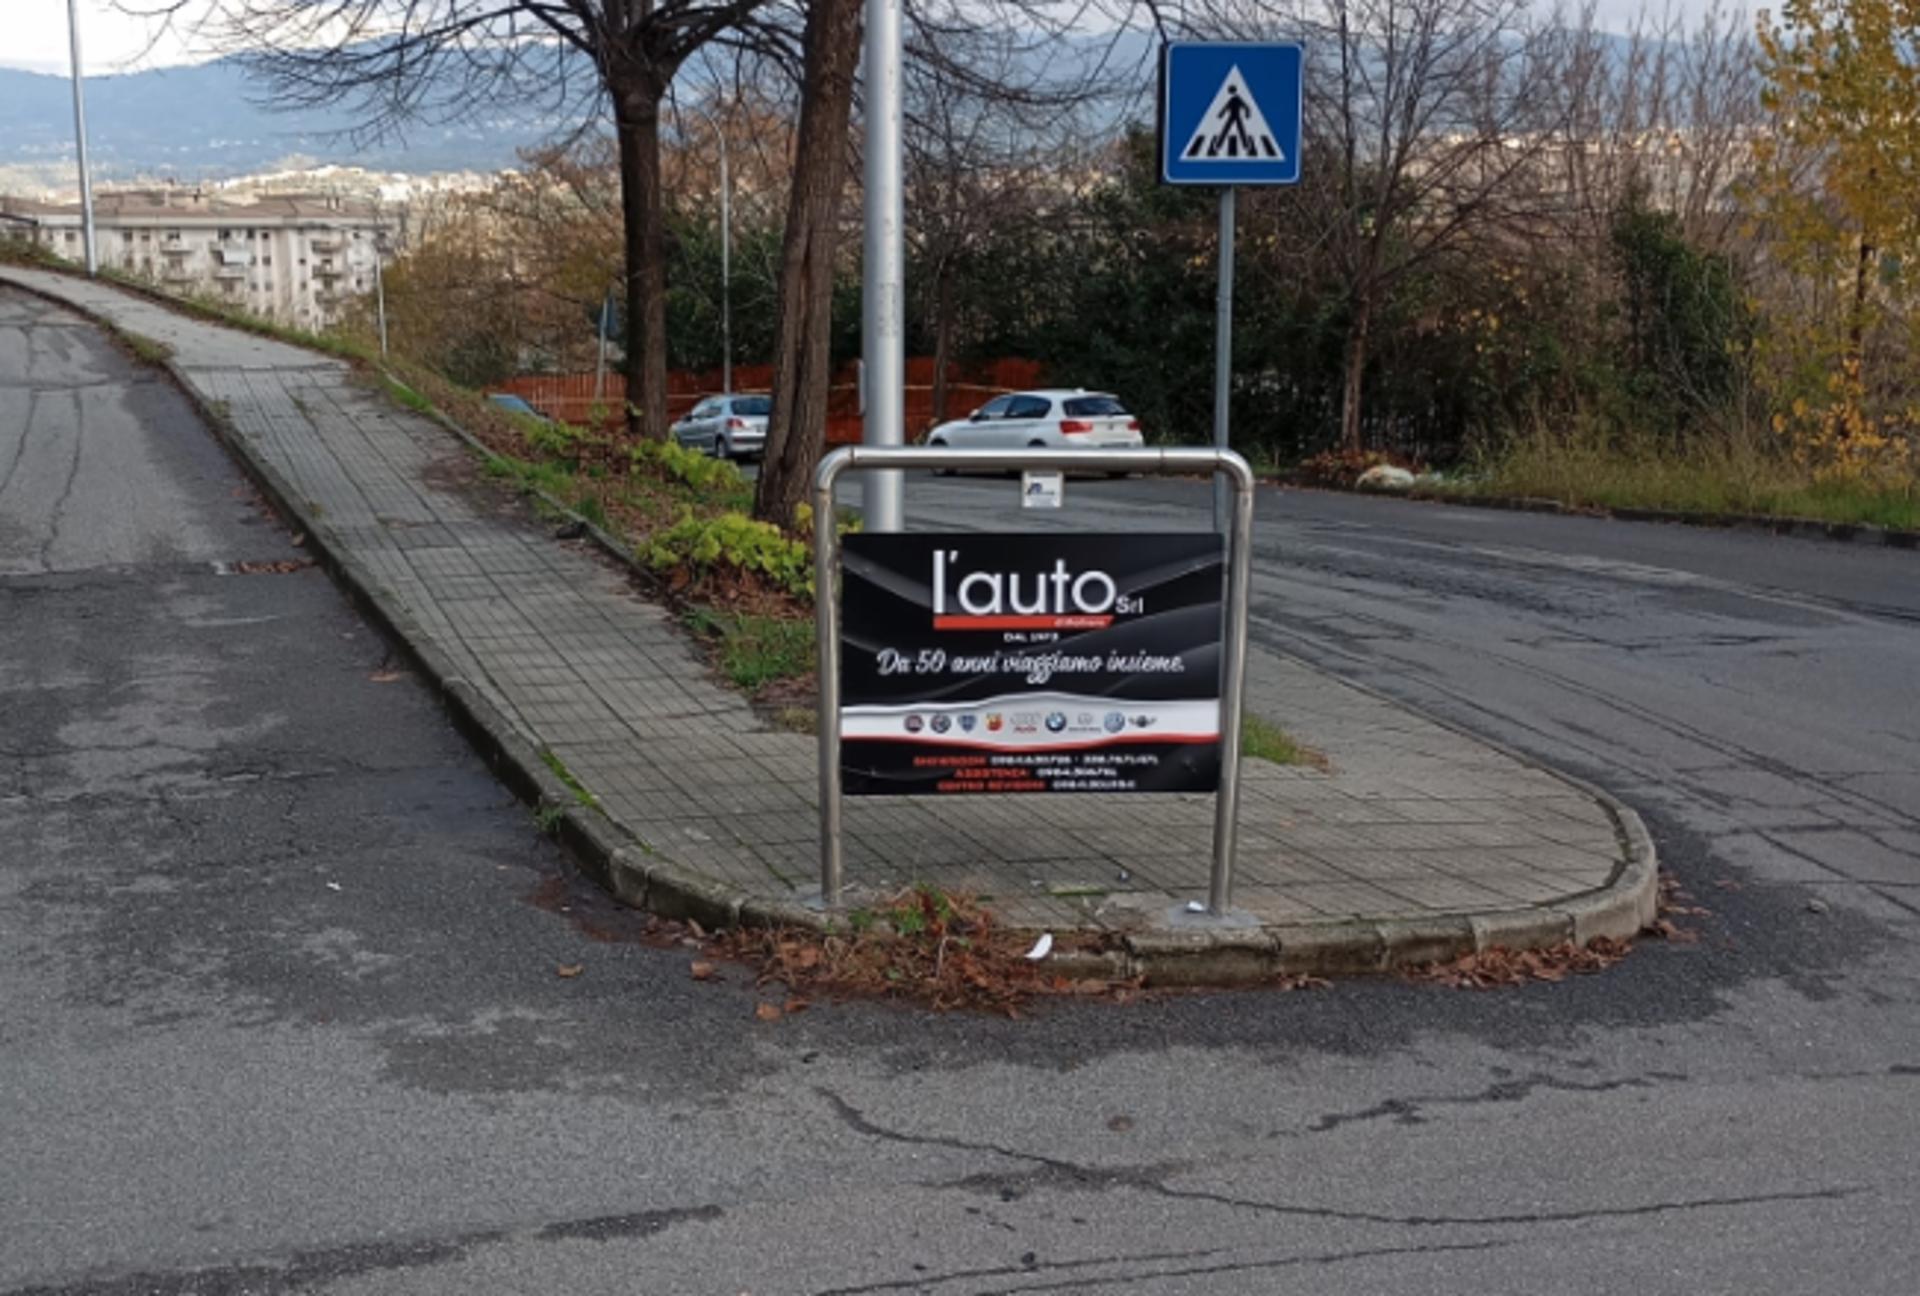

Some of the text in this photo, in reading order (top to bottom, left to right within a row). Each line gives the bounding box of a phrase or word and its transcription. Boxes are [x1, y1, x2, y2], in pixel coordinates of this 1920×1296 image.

[933, 550, 1143, 614] l'auto Srl
[876, 648, 910, 675] Da
[915, 649, 946, 673] 50
[951, 650, 1000, 673] anni
[1001, 650, 1102, 684] viaggiamo
